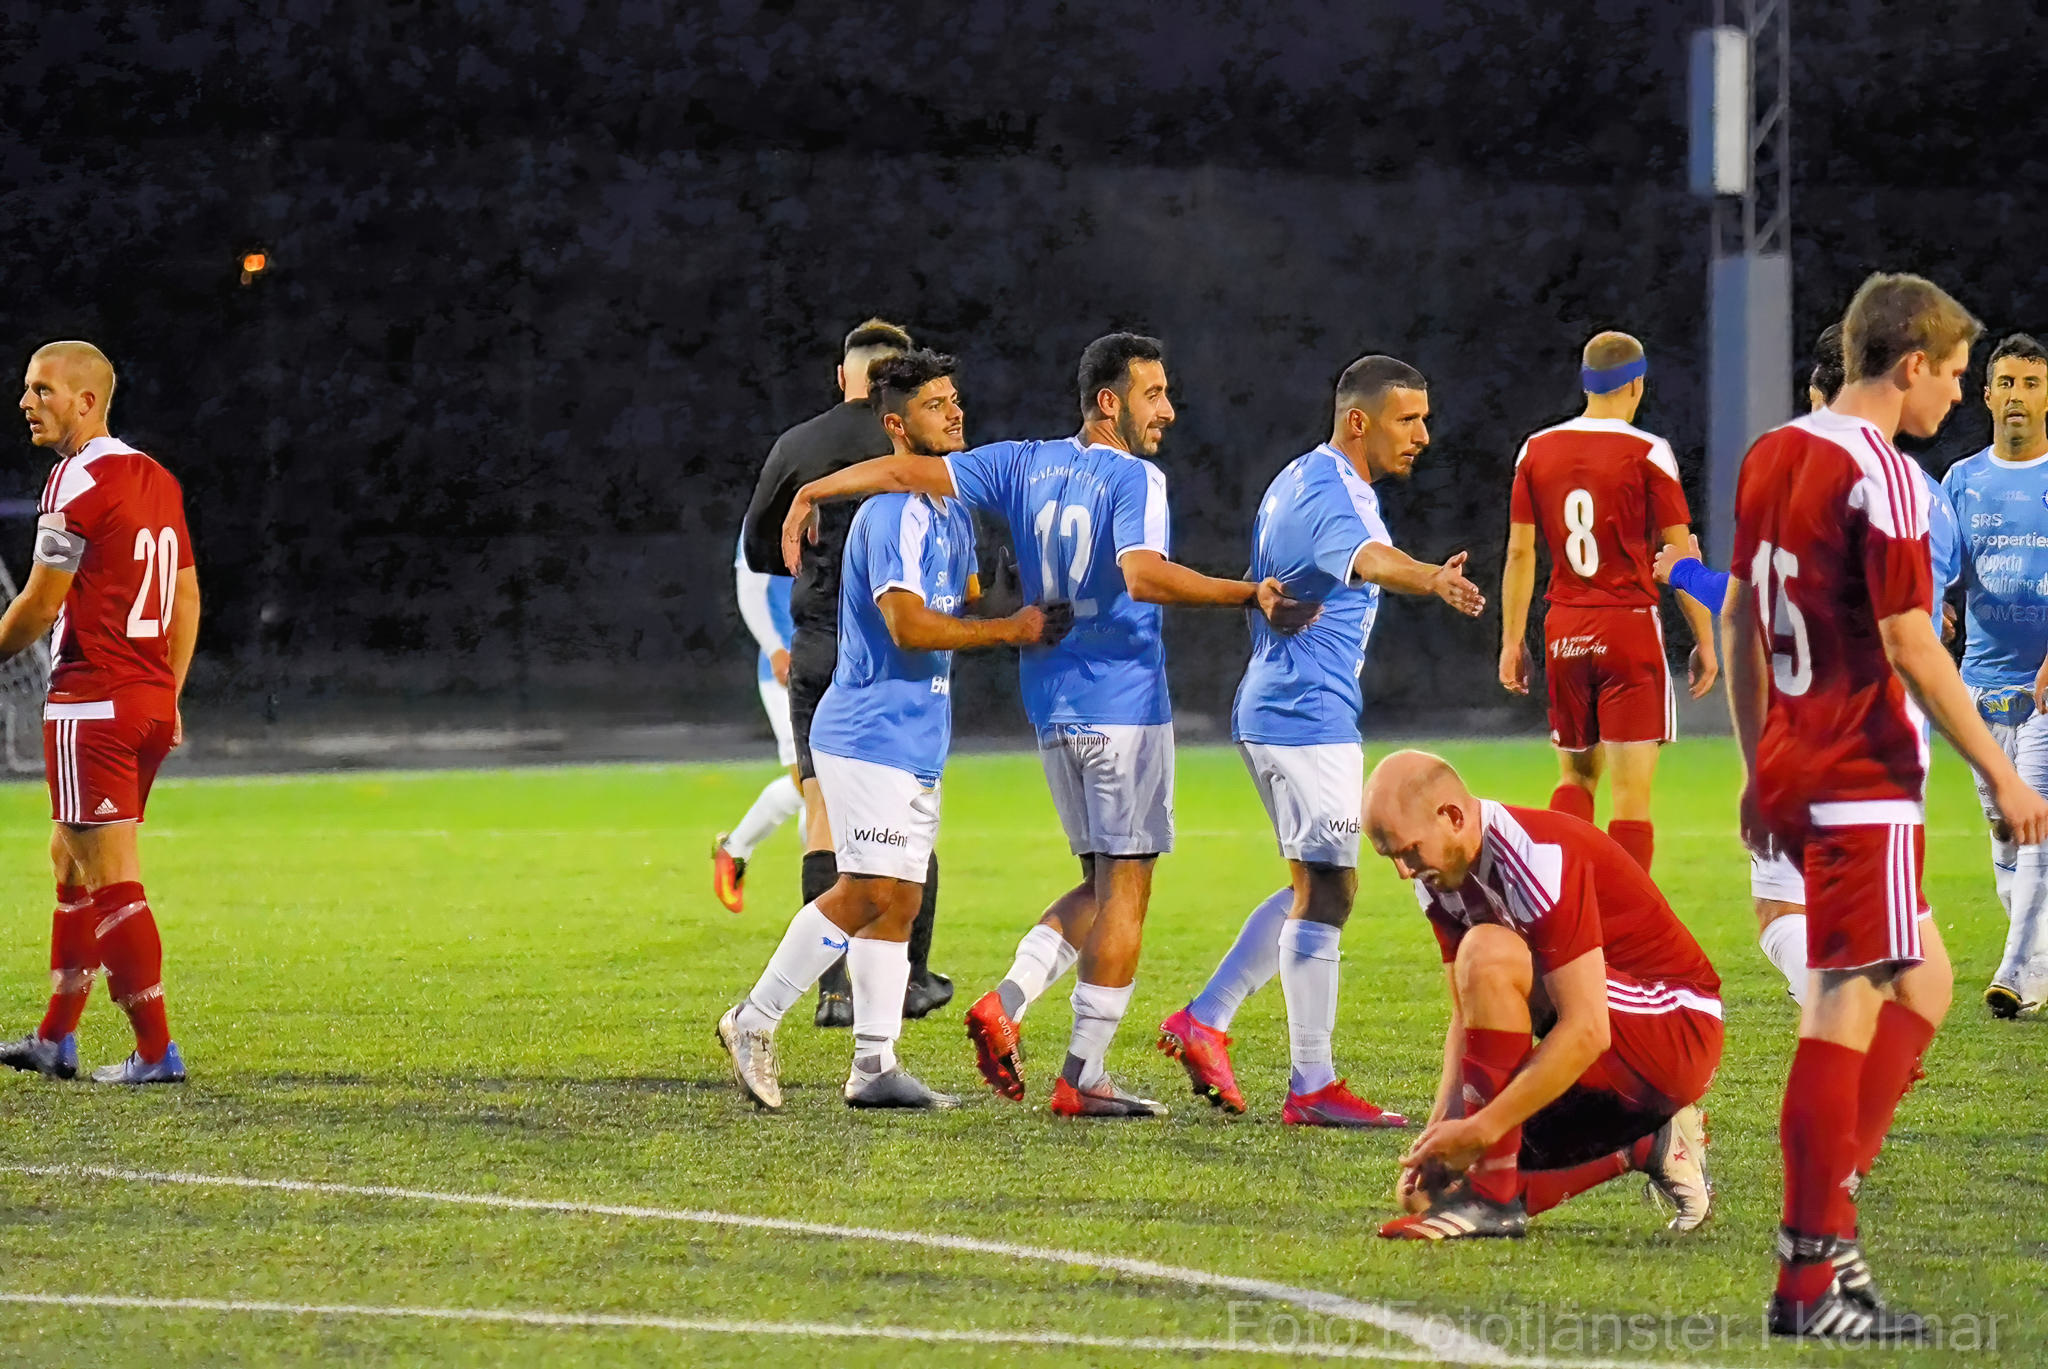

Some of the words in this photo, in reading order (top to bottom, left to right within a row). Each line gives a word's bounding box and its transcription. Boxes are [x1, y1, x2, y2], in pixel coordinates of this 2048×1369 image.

[35, 529, 72, 563] C
[1034, 500, 1097, 617] 12
[1564, 489, 1599, 577] 8
[1971, 513, 2003, 528] SRS
[127, 527, 178, 637] 20
[1752, 540, 1812, 696] 15
